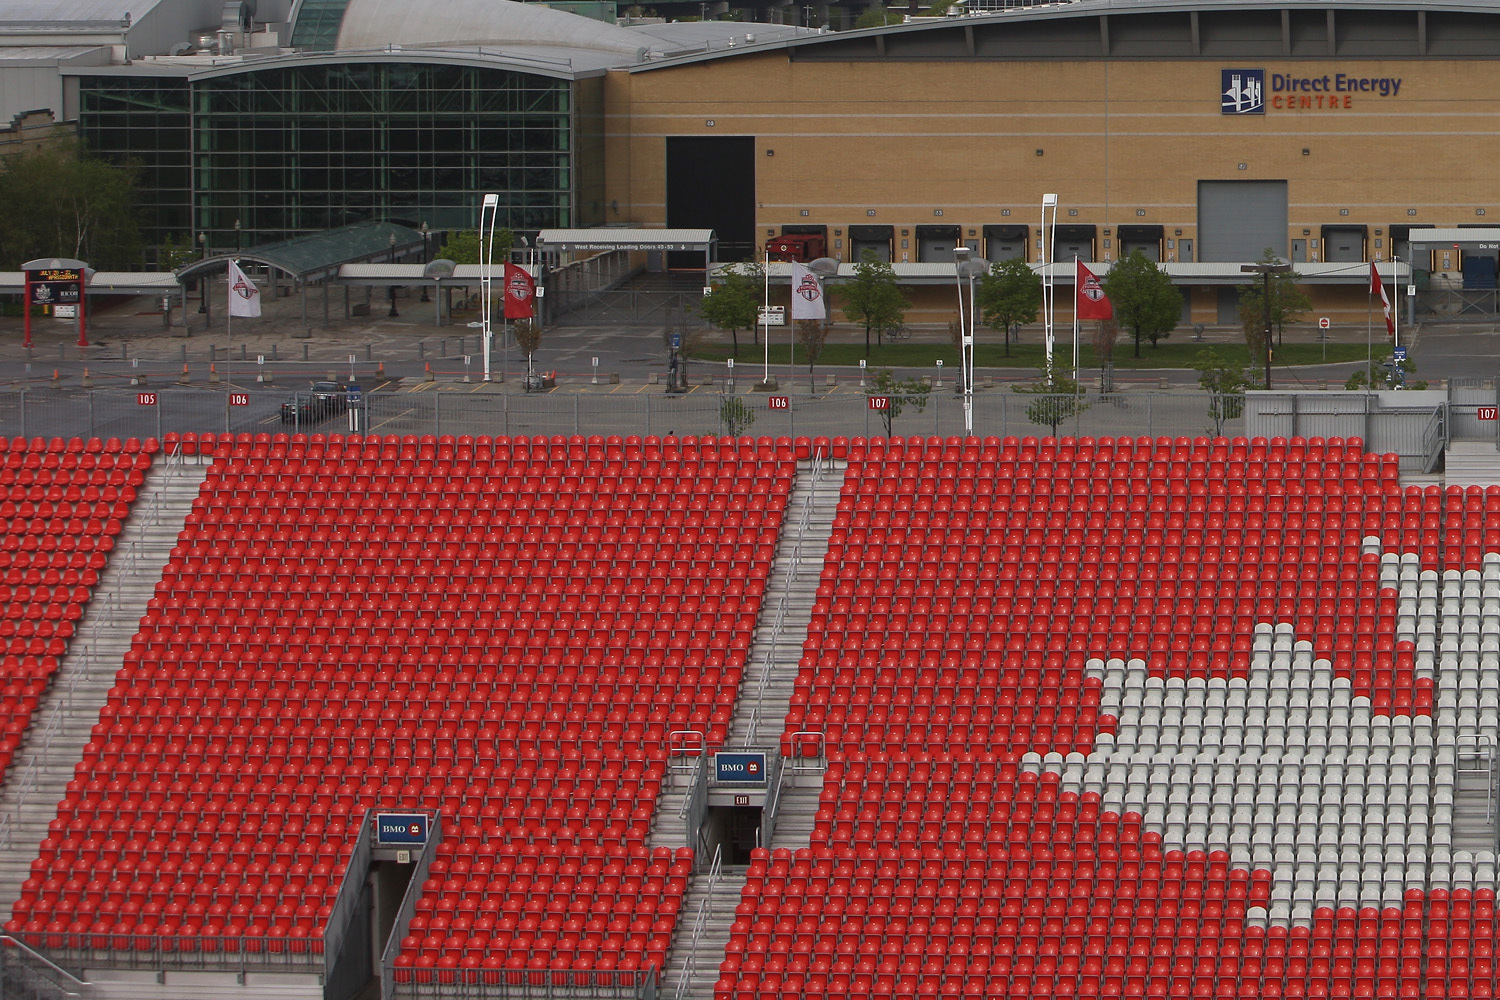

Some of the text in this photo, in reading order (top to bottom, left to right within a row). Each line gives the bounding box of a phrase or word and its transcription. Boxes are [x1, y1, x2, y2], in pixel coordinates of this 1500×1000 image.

[1272, 73, 1402, 96] Direct Energy
[1272, 95, 1353, 109] CENTRE
[140, 394, 155, 404] 105
[232, 395, 247, 405] 106
[771, 398, 786, 408] 106
[871, 398, 886, 408] 107
[1480, 409, 1496, 419] 107
[721, 764, 744, 772] BMO
[736, 796, 747, 804] EXIT
[383, 825, 406, 833] BMO
